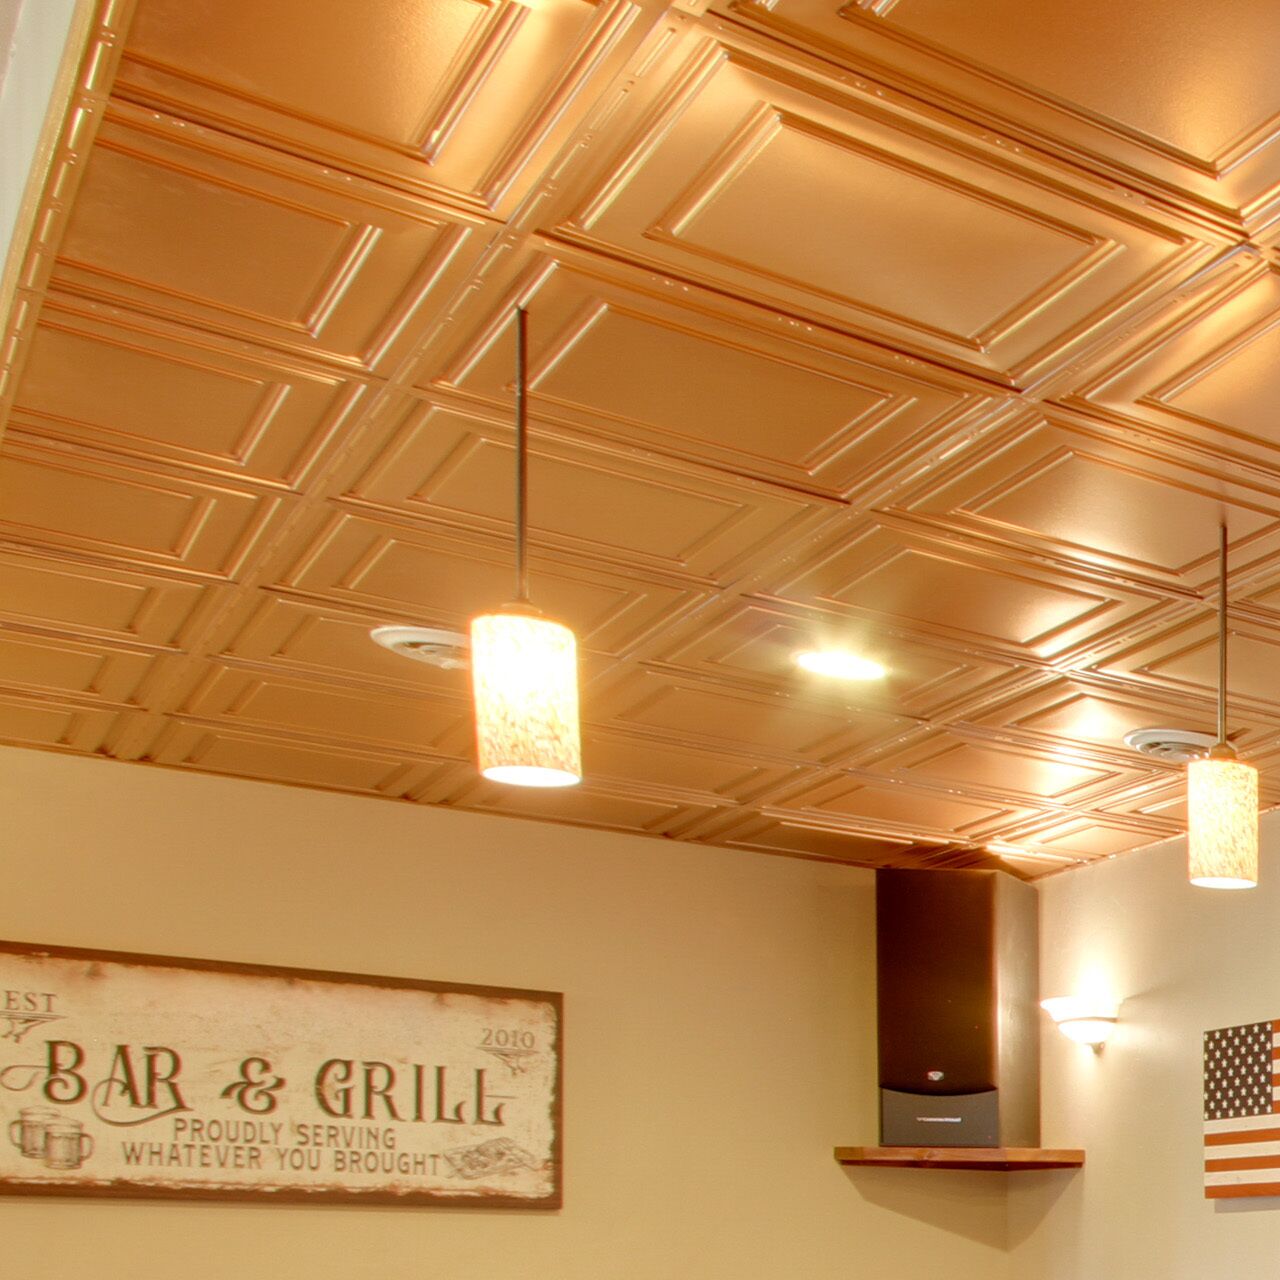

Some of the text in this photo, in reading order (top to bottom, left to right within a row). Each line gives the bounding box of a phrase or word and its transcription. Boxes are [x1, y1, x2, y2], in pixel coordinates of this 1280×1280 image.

[480, 1027, 536, 1049] 2010
[44, 1039, 507, 1127] BAR & GRILL
[174, 1117, 397, 1151] PROUDLY SERVING
[122, 1140, 443, 1177] WHATEVER YOU BROUGHT
